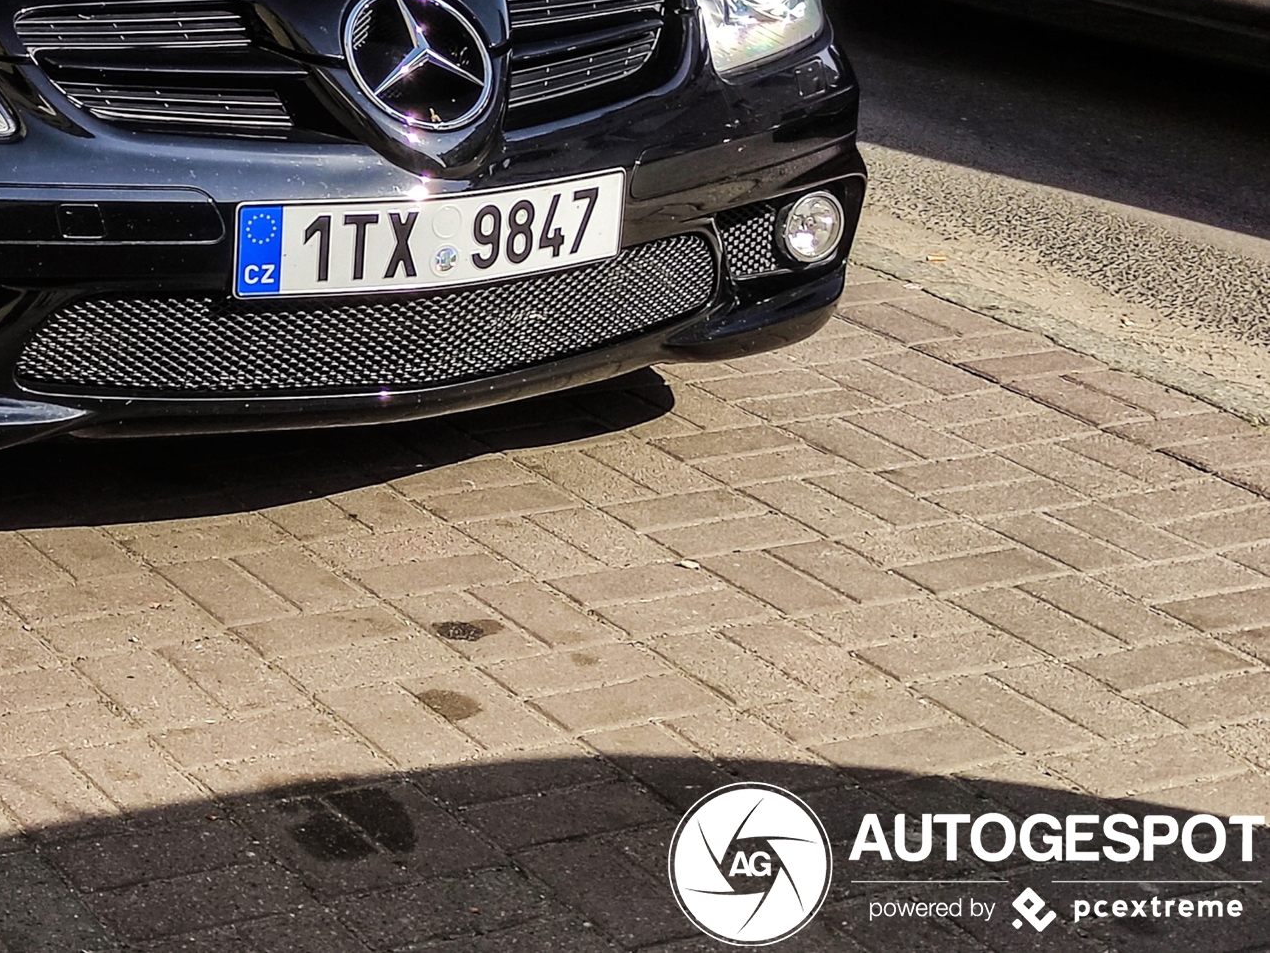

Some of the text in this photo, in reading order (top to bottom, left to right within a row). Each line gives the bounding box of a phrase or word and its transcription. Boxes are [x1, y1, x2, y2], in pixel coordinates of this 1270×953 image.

[303, 187, 599, 283] 1TX 9847
[244, 264, 276, 285] CZ
